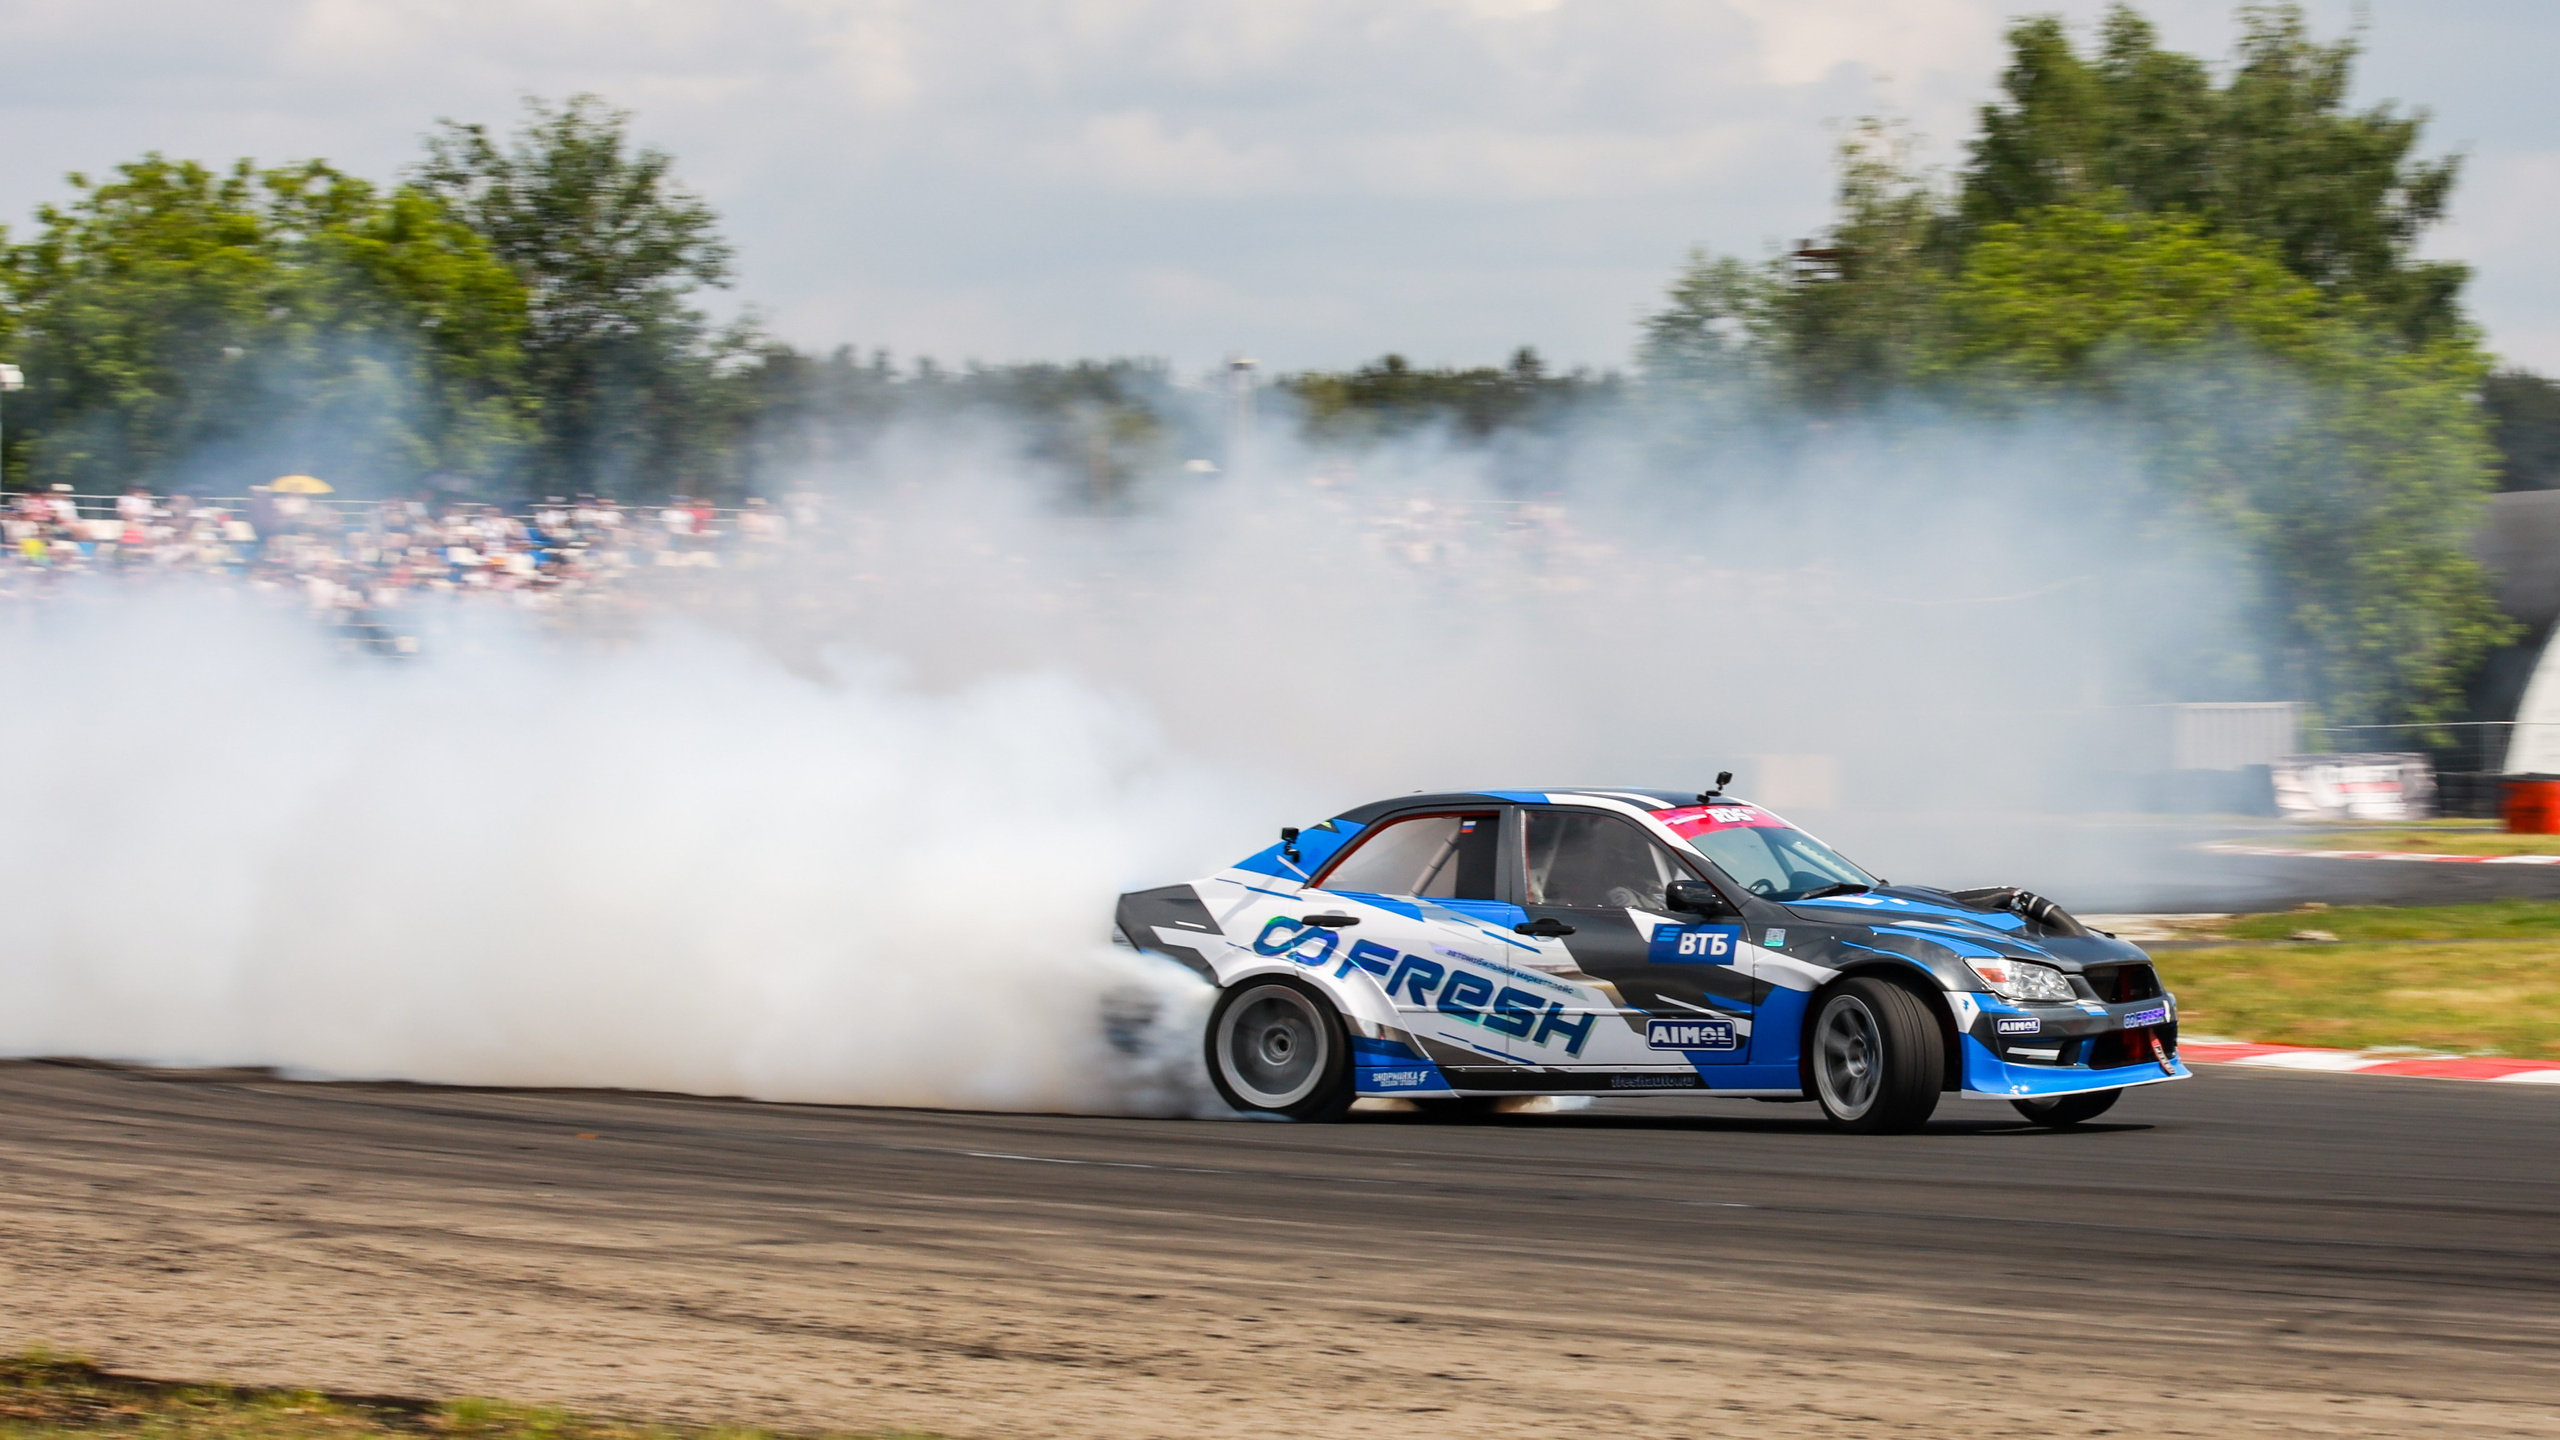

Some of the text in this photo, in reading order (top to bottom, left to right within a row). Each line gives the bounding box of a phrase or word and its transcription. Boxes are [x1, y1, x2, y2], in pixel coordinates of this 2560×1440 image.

[1678, 933, 1729, 955] ВТБ
[1446, 949, 1575, 995] автомобильный маркетплейс
[1650, 1026, 1732, 1044] AIMOL
[2000, 1021, 2038, 1031] AIMOL
[1611, 1074, 1696, 1088] freshauto.ru
